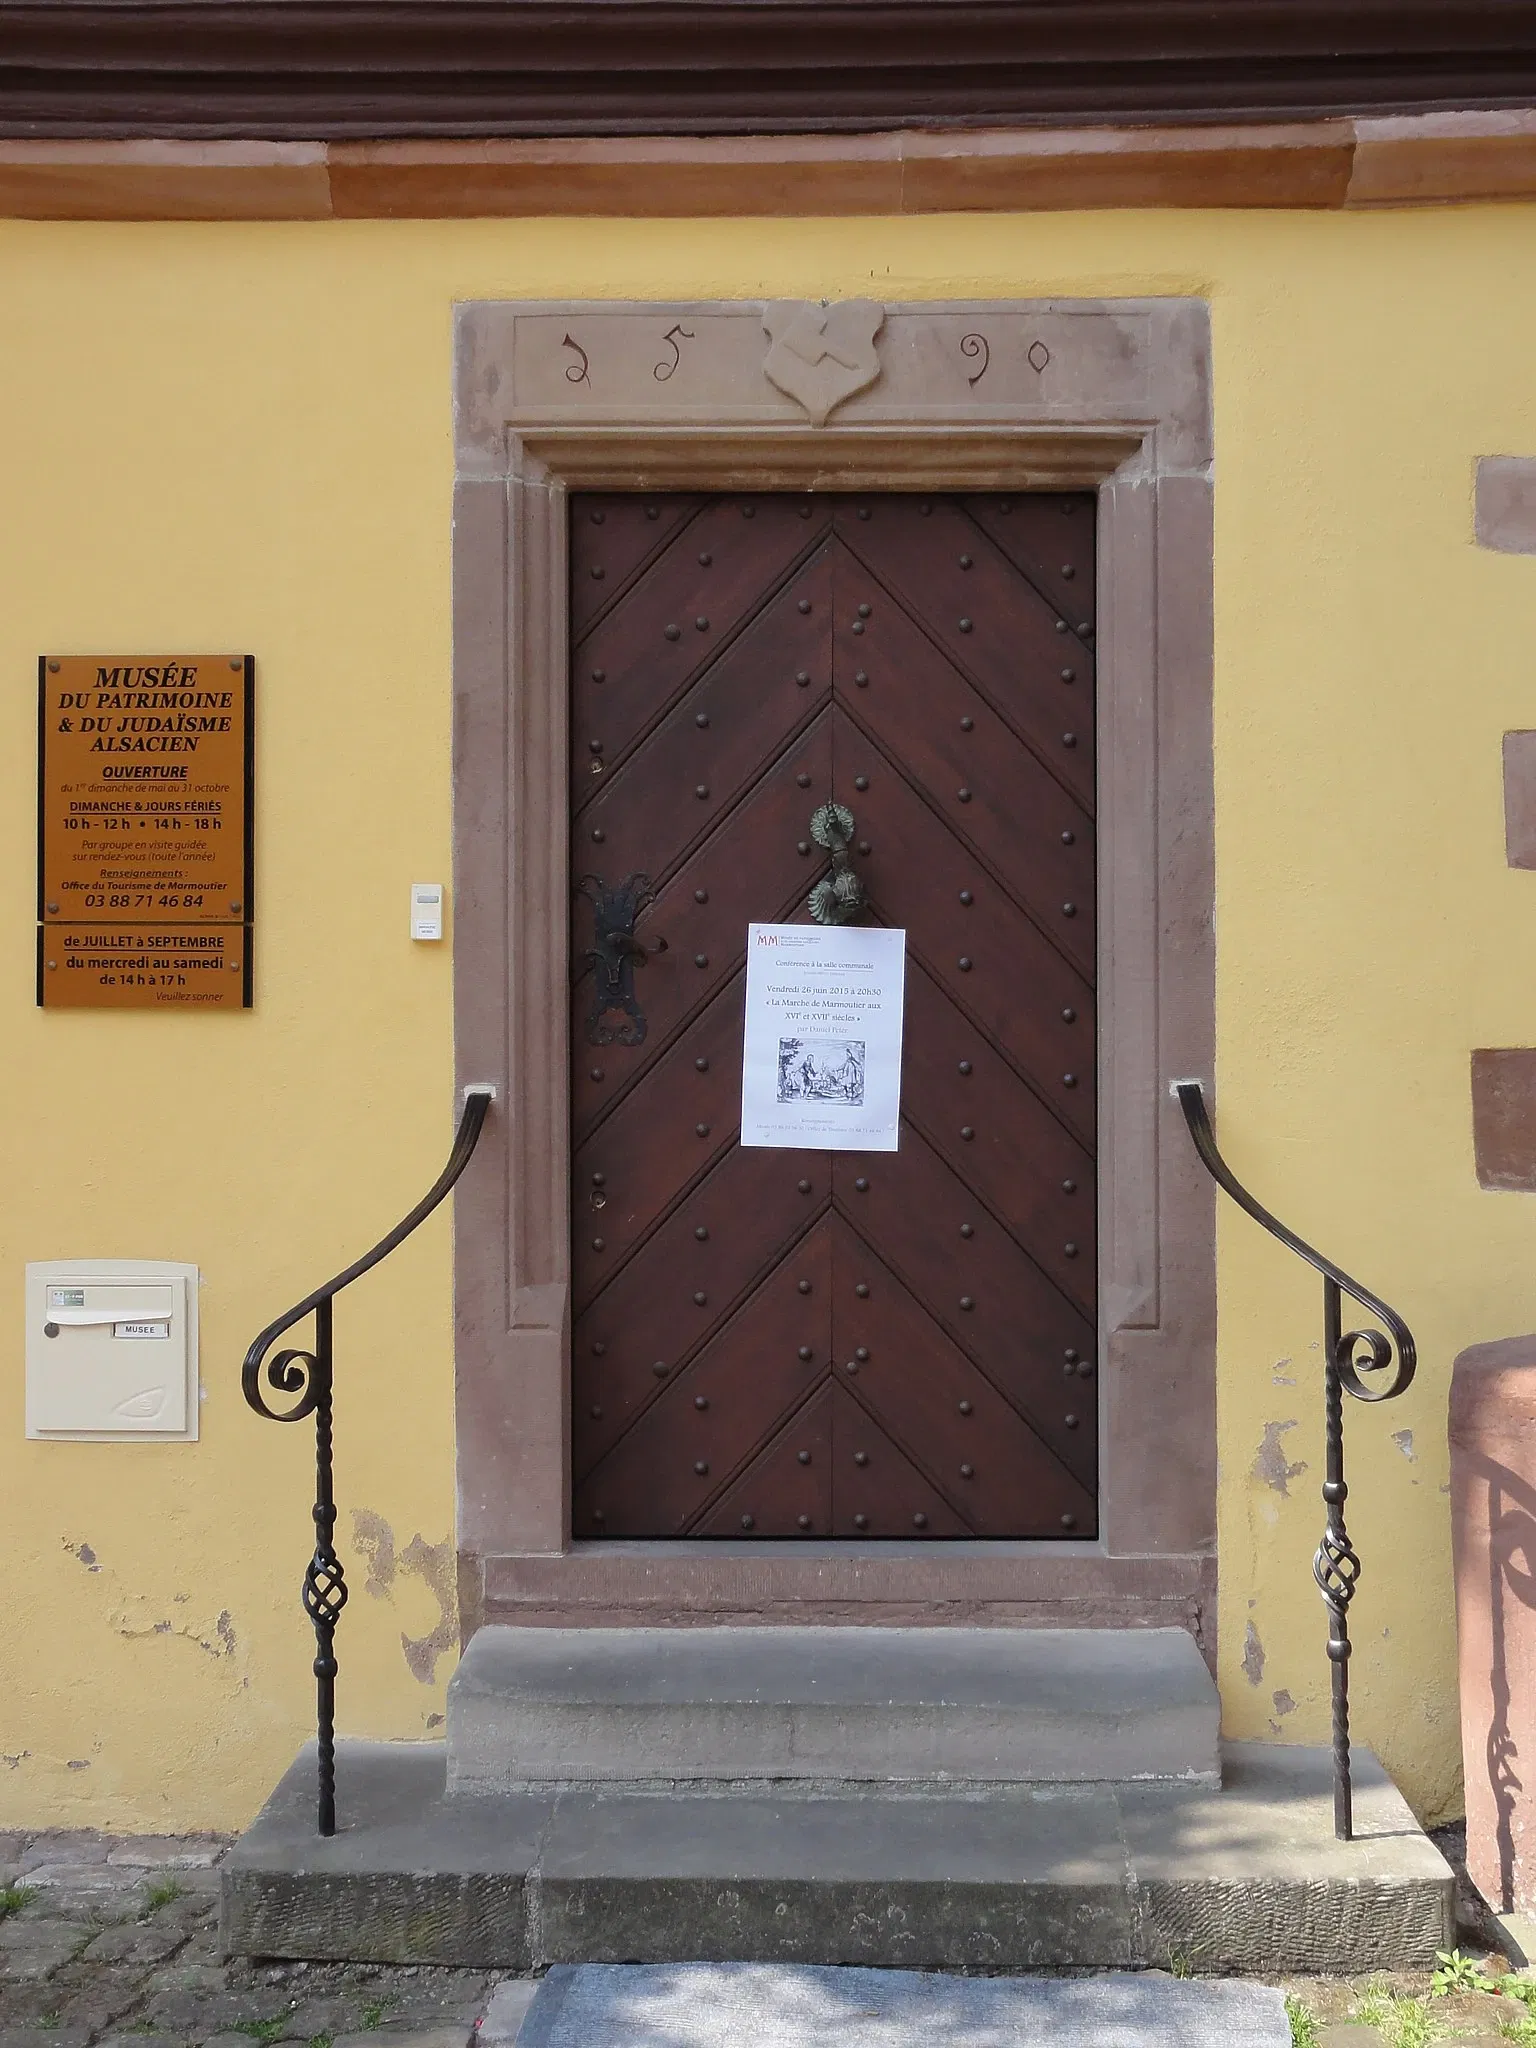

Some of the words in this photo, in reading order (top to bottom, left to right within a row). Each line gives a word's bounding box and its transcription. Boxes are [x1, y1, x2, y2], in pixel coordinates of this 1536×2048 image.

[93, 662, 198, 688] MUSÉE
[58, 693, 91, 709] DU
[96, 692, 233, 709] PATRIMOINE
[58, 717, 74, 732] &
[79, 717, 112, 732] DU
[117, 713, 232, 732] JUDAÏSME
[90, 736, 200, 752] ALSACIEN
[102, 766, 188, 778] OUVERTURE
[60, 783, 72, 793] du
[88, 783, 134, 793] dimanche
[135, 783, 146, 793] de
[148, 783, 166, 793] mai
[168, 783, 179, 793] au
[182, 783, 191, 793] 31
[195, 783, 230, 793] octobre
[70, 801, 132, 811] DIMANCHE
[134, 801, 142, 811] &
[144, 801, 181, 811] JOURS
[63, 818, 78, 829] 10
[82, 818, 90, 829] h
[103, 818, 118, 829] 12
[122, 818, 130, 829] h
[154, 818, 169, 829] 14
[173, 818, 181, 829] h
[194, 818, 209, 829] 18
[213, 818, 221, 829] h
[82, 840, 96, 849] Par
[99, 841, 133, 851] groupe
[149, 840, 173, 849] visite
[174, 840, 207, 851] guidée
[89, 852, 146, 861] rendez-vous
[149, 852, 177, 862] (toute
[100, 869, 183, 879] Renseignements
[61, 881, 89, 890] Office
[92, 881, 104, 890] du
[107, 881, 154, 890] Tourisme
[154, 881, 165, 890] de
[168, 881, 227, 890] Marmoutier
[85, 894, 105, 908] 03
[109, 894, 130, 908] 88
[134, 894, 153, 908] 71
[158, 894, 179, 908] 46
[182, 894, 203, 908] 84
[64, 936, 80, 947] de
[82, 936, 134, 947] JUILLET
[136, 936, 144, 947] à
[147, 936, 224, 947] SEPTEMBRE
[757, 935, 778, 946] MM
[66, 956, 84, 969] du
[88, 956, 149, 969] mercredi
[153, 959, 170, 969] au
[173, 956, 223, 969] samedi
[775, 960, 809, 968] Conférence
[838, 962, 874, 970] communale
[99, 974, 116, 985] de
[120, 974, 134, 985] 14
[138, 974, 145, 985] h
[148, 974, 156, 985] à
[160, 974, 173, 985] 17
[178, 974, 186, 985] h
[766, 985, 800, 993] Vendredi
[801, 986, 812, 994] 26
[812, 987, 828, 996] juin
[830, 986, 849, 995] 2015
[857, 987, 882, 996] 20h30
[156, 992, 190, 1001] Veuillez
[782, 999, 810, 1007] Marche
[811, 1000, 820, 1008] de
[822, 1000, 865, 1009] Marmoutier
[125, 1326, 155, 1334] MUSEE
